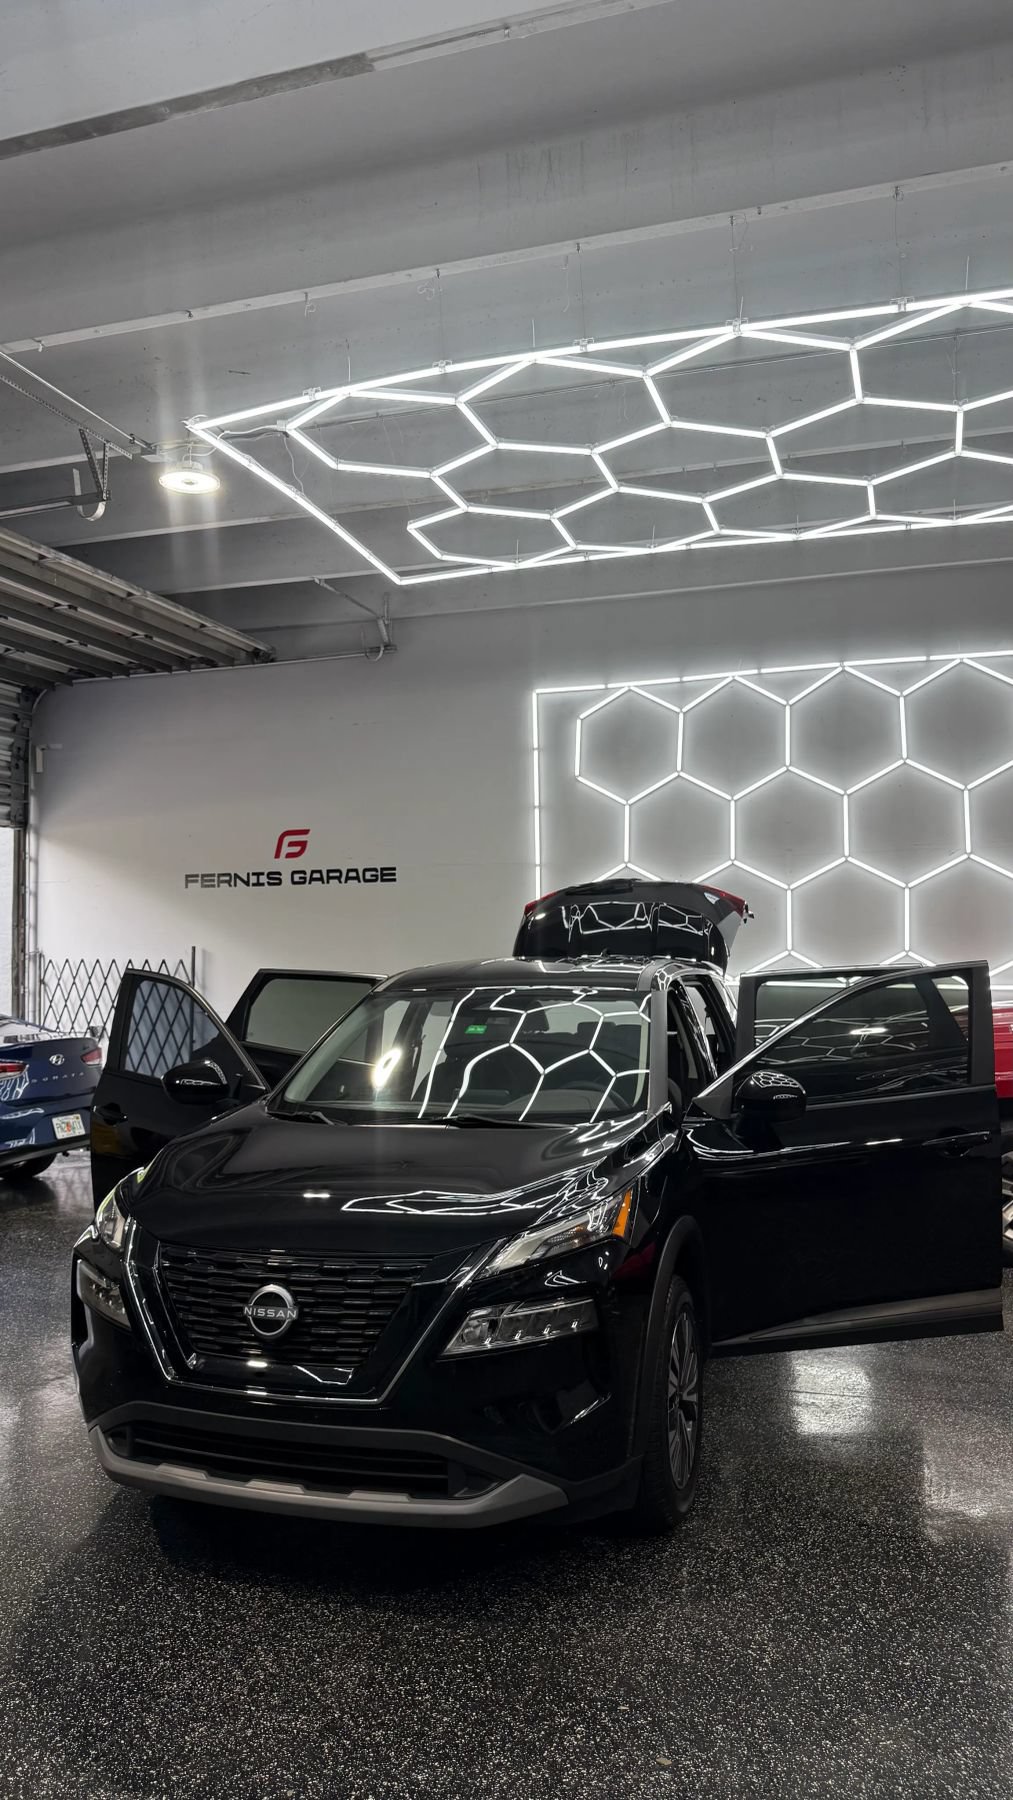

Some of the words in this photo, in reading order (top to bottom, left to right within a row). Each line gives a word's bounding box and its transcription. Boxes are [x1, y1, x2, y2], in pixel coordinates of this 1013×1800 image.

[184, 871, 283, 888] FERNIS
[290, 867, 397, 885] GARAGE
[244, 1306, 298, 1318] NISSAN
